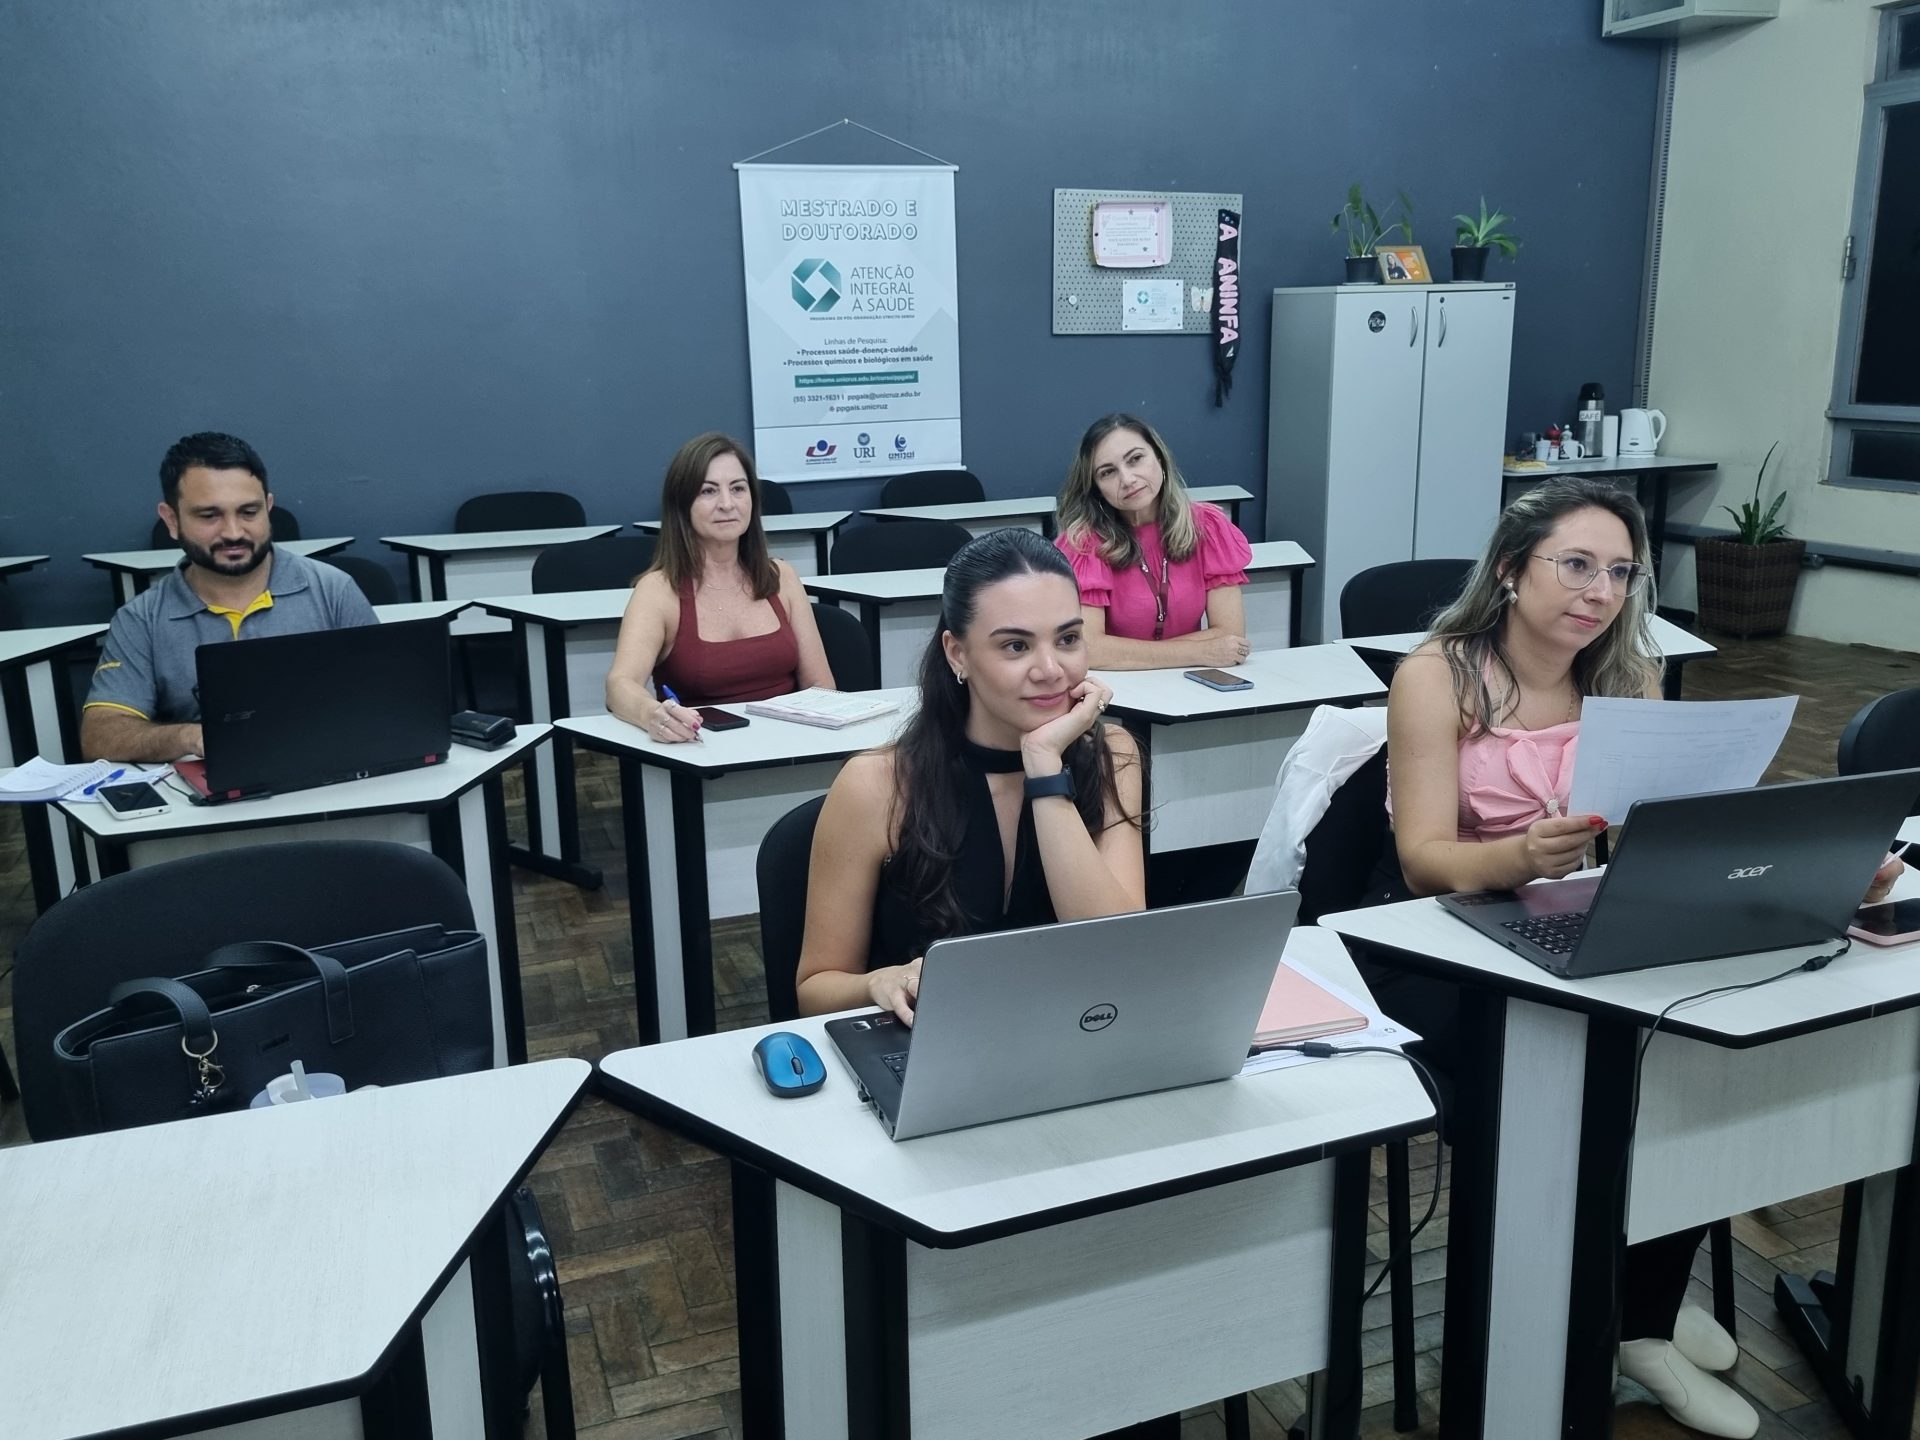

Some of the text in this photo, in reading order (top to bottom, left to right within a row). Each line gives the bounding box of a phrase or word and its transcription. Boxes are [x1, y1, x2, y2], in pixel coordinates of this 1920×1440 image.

[781, 199, 918, 217] MESTRADO E
[782, 223, 918, 241] DOUTORADO
[850, 264, 915, 281] ATENÇÃO
[850, 282, 915, 296] INTEGRAL
[857, 337, 888, 345] Pesquisa:
[838, 345, 918, 355] saúde-doença-cuidado
[787, 359, 823, 367] Processos
[863, 356, 899, 365] biológicos
[912, 354, 934, 362] saúde
[853, 447, 876, 459] URI
[1727, 864, 1773, 879] acer
[1084, 1012, 1113, 1023] DELL
